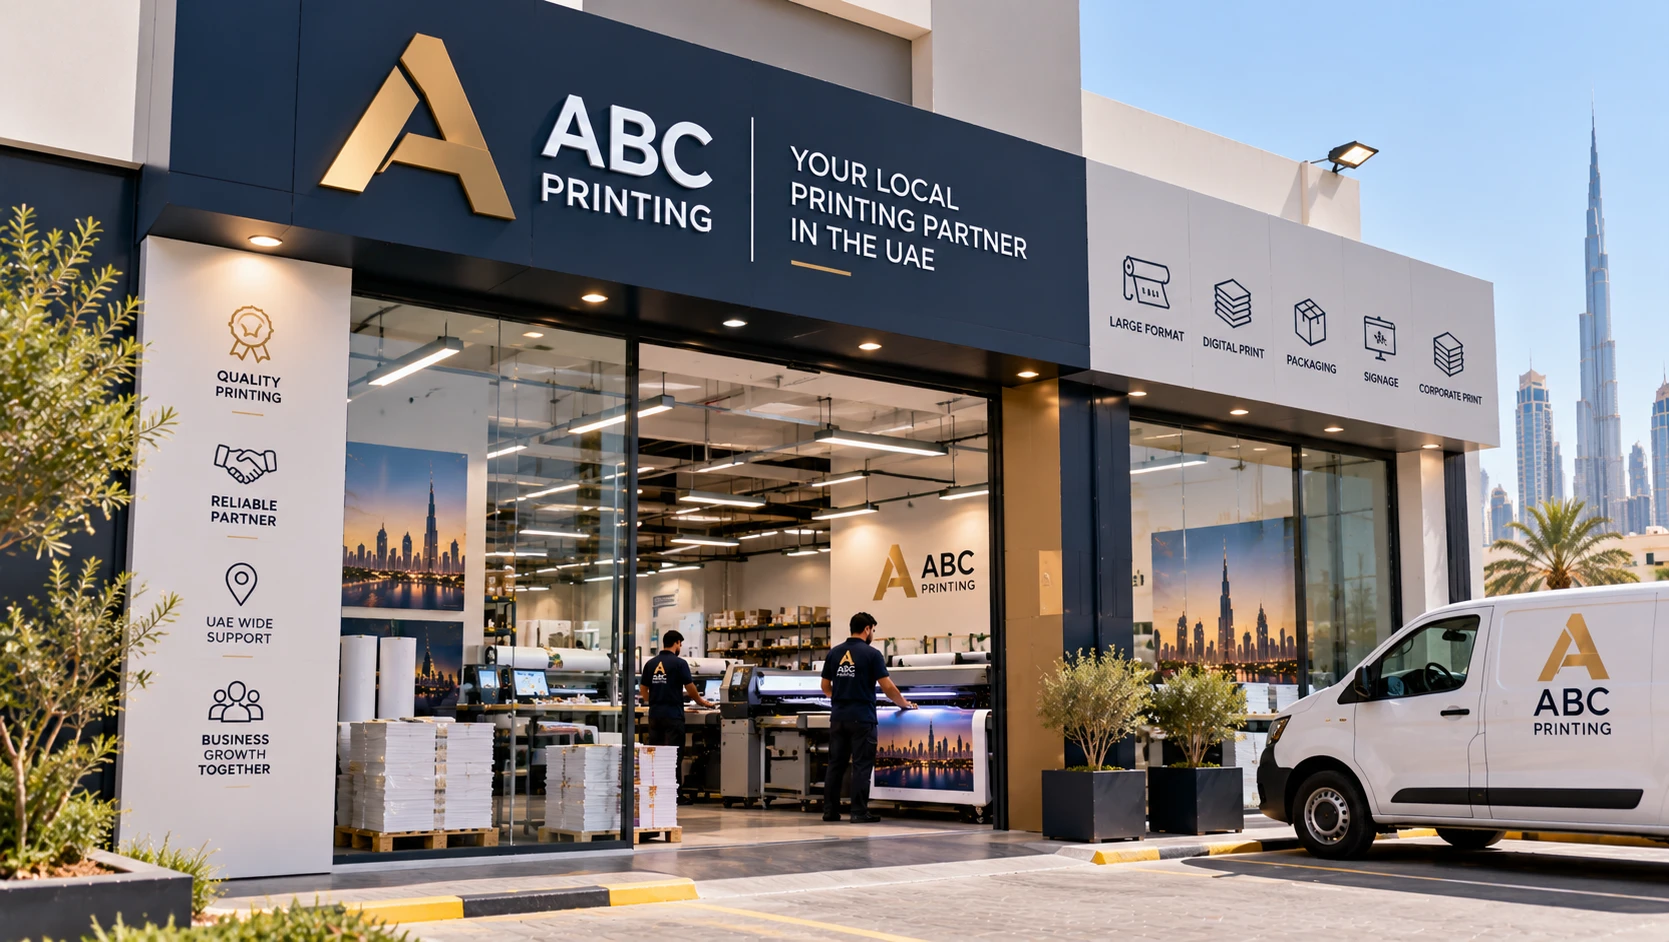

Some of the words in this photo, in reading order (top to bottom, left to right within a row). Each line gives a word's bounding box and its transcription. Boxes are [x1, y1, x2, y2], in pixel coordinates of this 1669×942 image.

[541, 93, 713, 189] ABC
[790, 145, 868, 188] YOUR
[877, 167, 960, 211] LOCAL
[541, 172, 713, 233] PRINTING
[791, 181, 915, 234] PRINTING
[923, 213, 1028, 260] PARTNER
[791, 217, 817, 246] IN
[826, 224, 877, 259] THE
[886, 238, 935, 272] UAE
[1109, 315, 1143, 333] LARGE
[1144, 323, 1185, 342] FORMAT
[1202, 335, 1238, 354] DIGITAL
[1239, 343, 1265, 359] PRINT
[1286, 354, 1337, 375] PACKAGING
[217, 370, 281, 389] QUALITY
[1363, 371, 1399, 388] SIGNAGE
[215, 385, 282, 404] PRINTING
[1418, 383, 1462, 402] CORPORATE
[211, 495, 278, 512] RELIABLE
[211, 510, 277, 527] PARTNER
[921, 549, 975, 579] ABC
[921, 579, 976, 594] PRINTING
[206, 616, 234, 628] UAE
[238, 617, 273, 629] WIDE
[206, 631, 272, 644] SUPPORT
[1533, 686, 1610, 717] ABC
[1533, 721, 1612, 736] PRINTING
[201, 733, 270, 746] BUSINESS
[203, 749, 266, 761] GROWTH
[197, 763, 271, 776] TOGETHER
